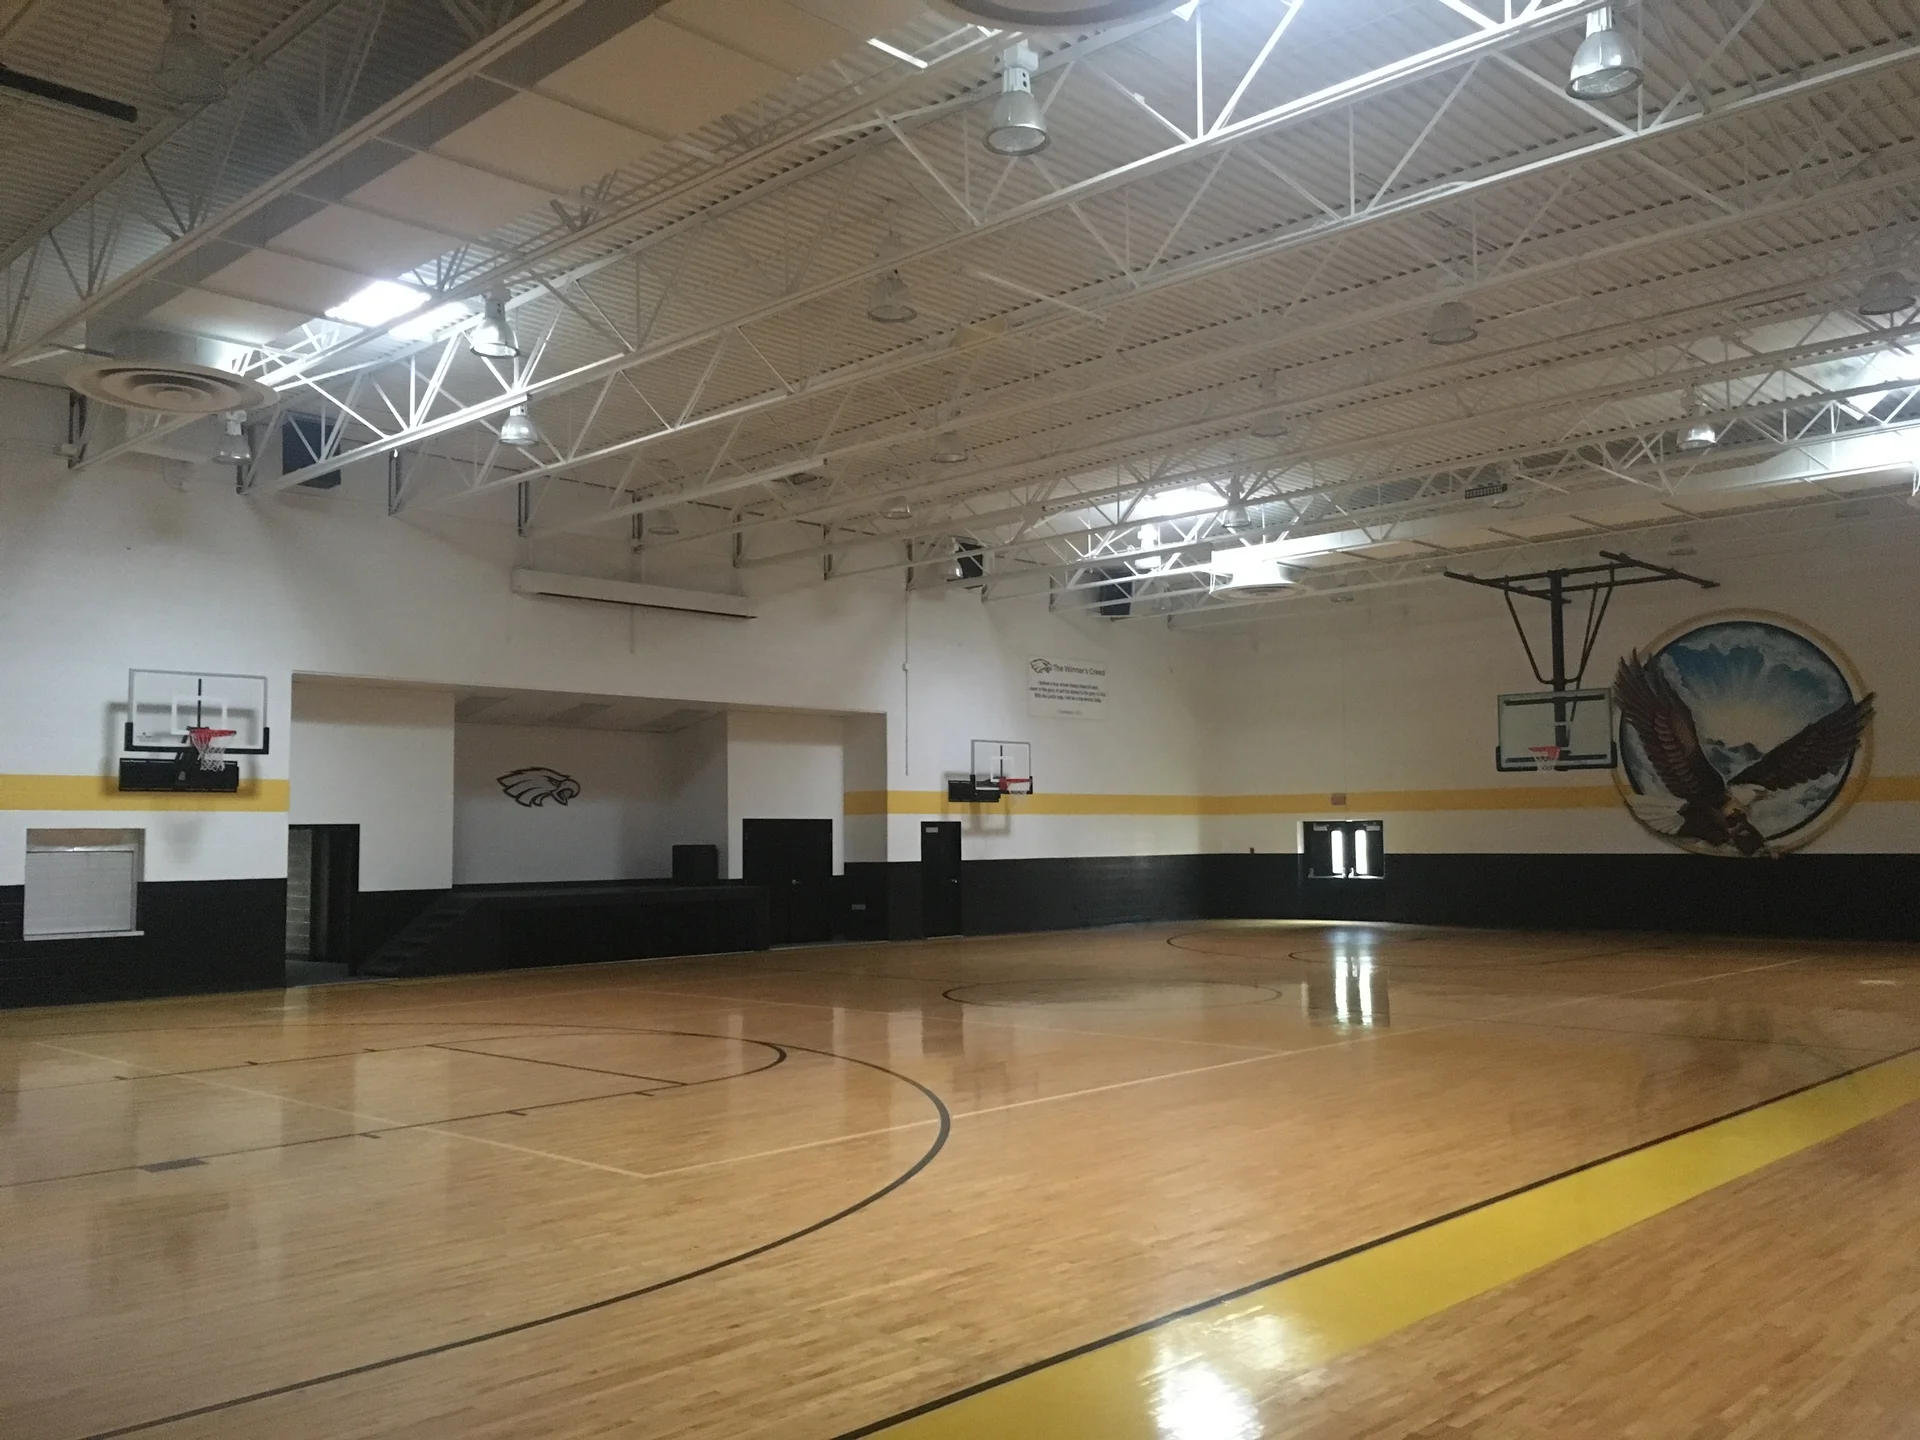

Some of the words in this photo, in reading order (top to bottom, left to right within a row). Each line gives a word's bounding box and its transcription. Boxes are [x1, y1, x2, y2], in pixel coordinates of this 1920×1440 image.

[1053, 664, 1064, 672] The
[1064, 665, 1088, 674] Winner's
[1089, 667, 1105, 676] Creed
